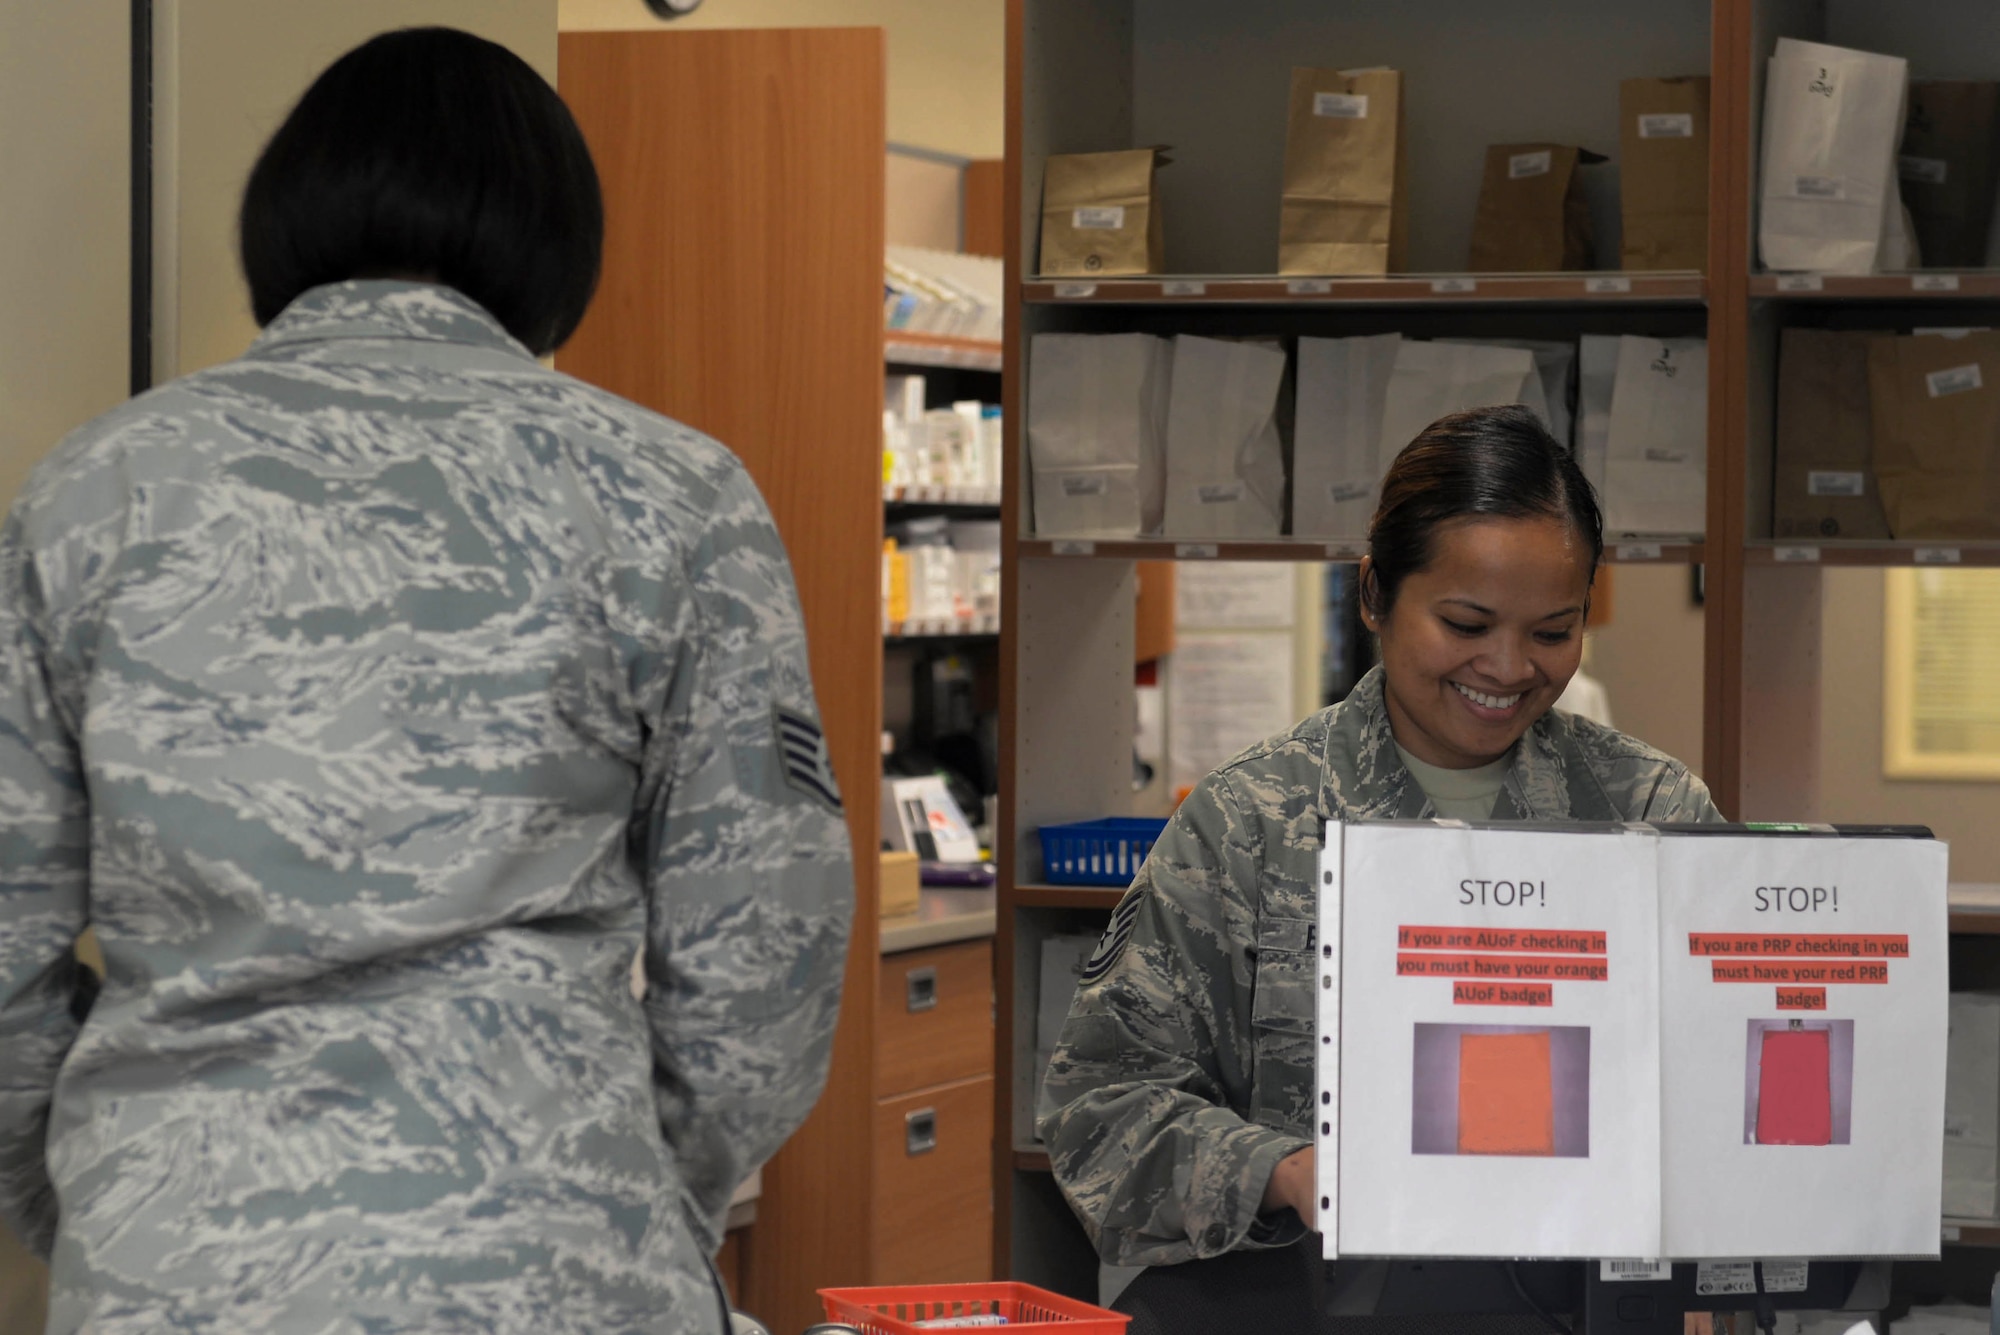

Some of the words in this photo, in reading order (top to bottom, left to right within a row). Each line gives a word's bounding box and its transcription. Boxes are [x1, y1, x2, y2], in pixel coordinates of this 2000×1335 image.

[1459, 879, 1545, 907] STOP!
[1755, 886, 1838, 912] STOP!
[1398, 930, 1409, 944] If
[1414, 933, 1442, 947] you
[1446, 934, 1472, 946] are
[1477, 933, 1516, 948] AUoF
[1521, 934, 1587, 952] checking
[1592, 936, 1606, 951] in
[1689, 938, 1700, 950] If
[1703, 940, 1730, 954] you
[1735, 939, 1758, 952] are
[1763, 939, 1791, 952] PRP
[1795, 939, 1859, 955] checking
[1864, 939, 1878, 953] in
[1882, 941, 1909, 955] you
[1397, 960, 1426, 974] you
[1430, 959, 1469, 973] must
[1475, 960, 1510, 974] have
[1515, 963, 1549, 976] your
[1554, 965, 1607, 980] orange
[1713, 966, 1749, 978] must
[1754, 966, 1789, 978] have
[1793, 968, 1826, 981] your
[1831, 966, 1855, 979] red
[1860, 966, 1887, 979] PRP
[1453, 987, 1494, 1000] AUoF
[1500, 988, 1552, 1005] badge!
[1776, 992, 1826, 1008] badge!
